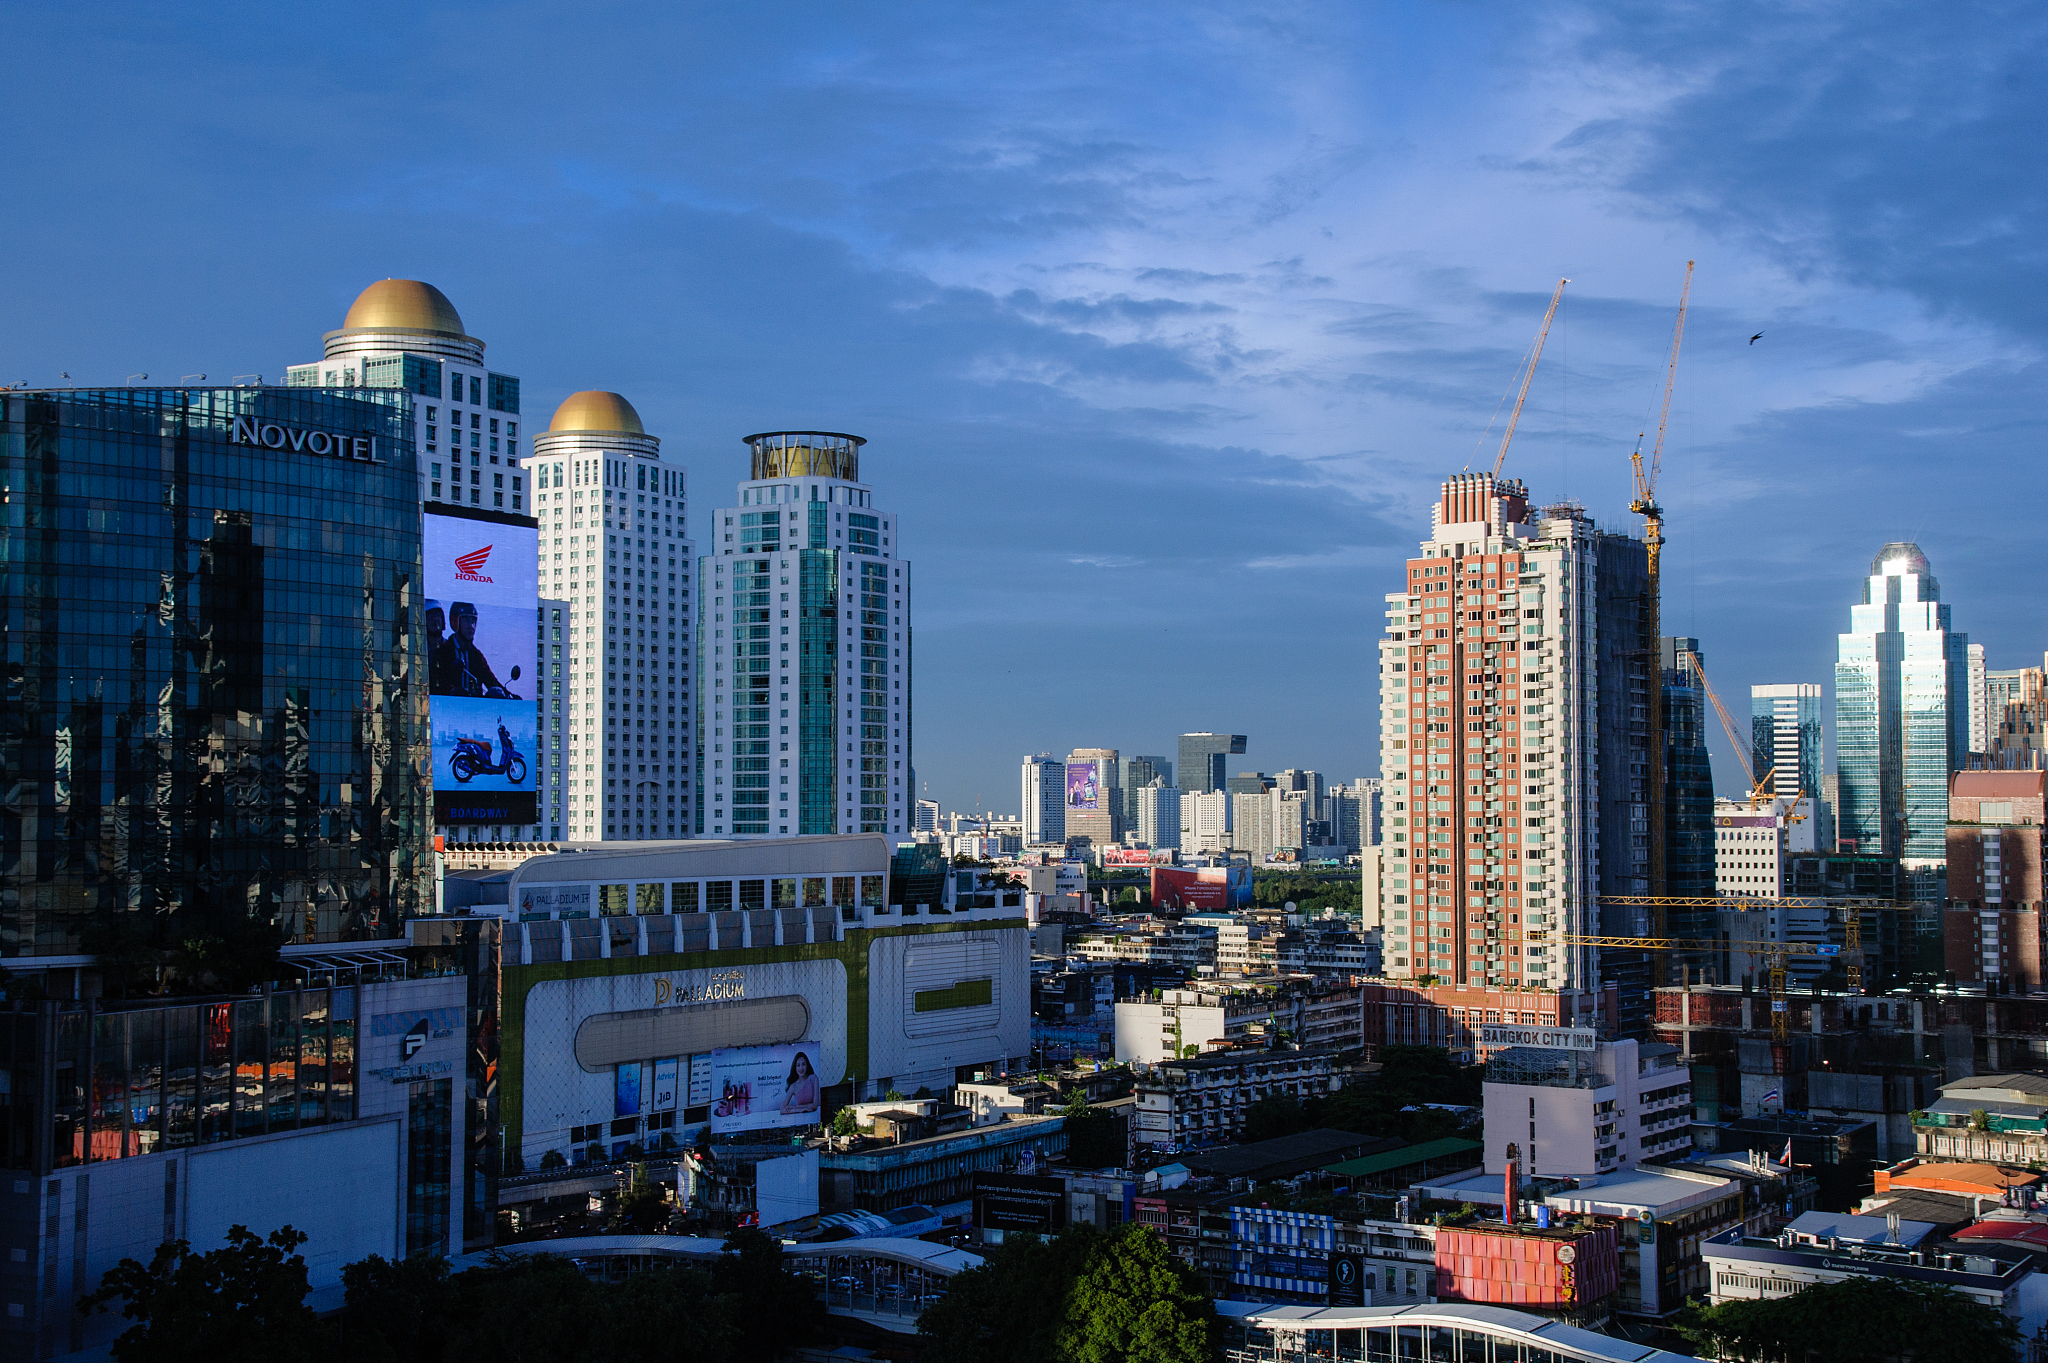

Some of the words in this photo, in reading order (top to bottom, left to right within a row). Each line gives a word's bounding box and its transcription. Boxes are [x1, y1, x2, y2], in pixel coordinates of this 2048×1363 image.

[232, 413, 388, 464] NOVOTEL
[455, 572, 494, 584] HONDA
[450, 808, 509, 819] BOARDWAY
[536, 893, 580, 905] PALLADIUM
[581, 893, 590, 903] IT
[675, 982, 745, 1003] PALLADIUM
[1483, 1029, 1539, 1045] BANGKOK
[1542, 1032, 1570, 1047] CITY
[1573, 1034, 1593, 1048] INN
[656, 1072, 676, 1081] Advice
